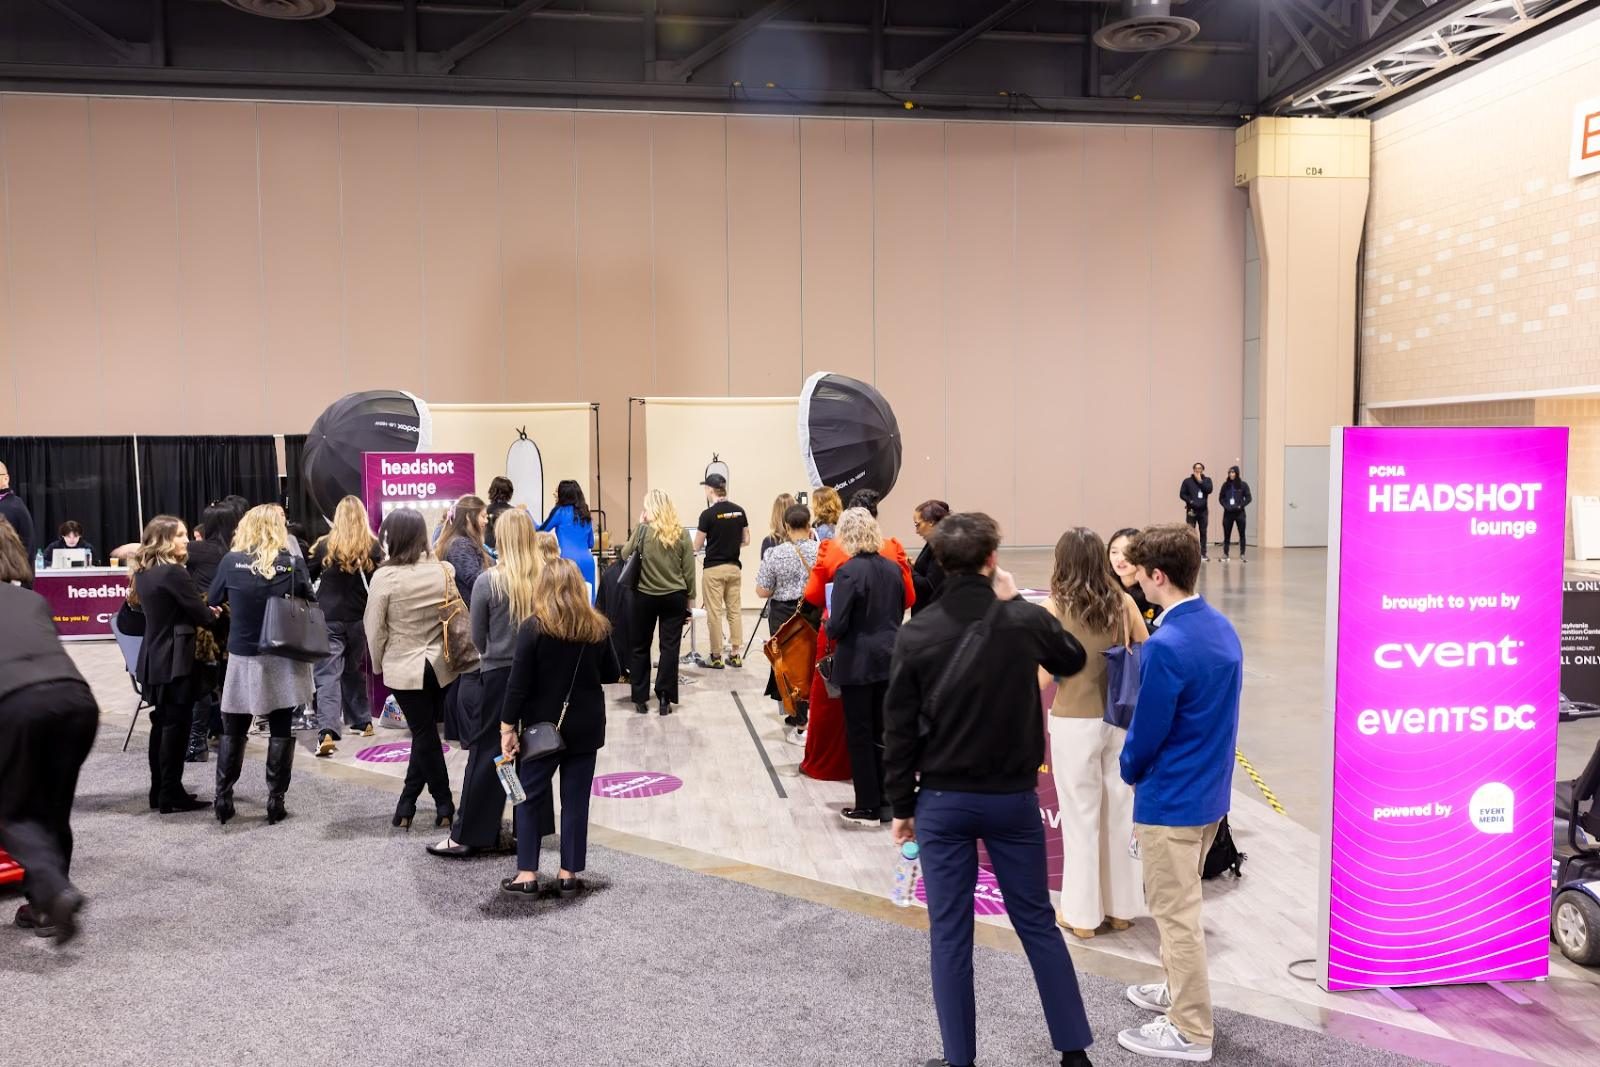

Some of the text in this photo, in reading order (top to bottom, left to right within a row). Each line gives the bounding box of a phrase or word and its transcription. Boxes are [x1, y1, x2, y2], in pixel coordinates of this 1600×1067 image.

[1305, 167, 1323, 176] CD4
[381, 458, 454, 475] headshot
[1368, 465, 1406, 477] PCMA
[381, 479, 436, 499] lounge
[1368, 483, 1542, 512] HEADSHOT
[1471, 517, 1537, 539] lounge
[1382, 592, 1520, 613] brought to you by
[1373, 634, 1520, 669] cvent
[1493, 704, 1536, 731] DC
[1373, 802, 1452, 821] powered by
[1480, 807, 1505, 815] EVENT
